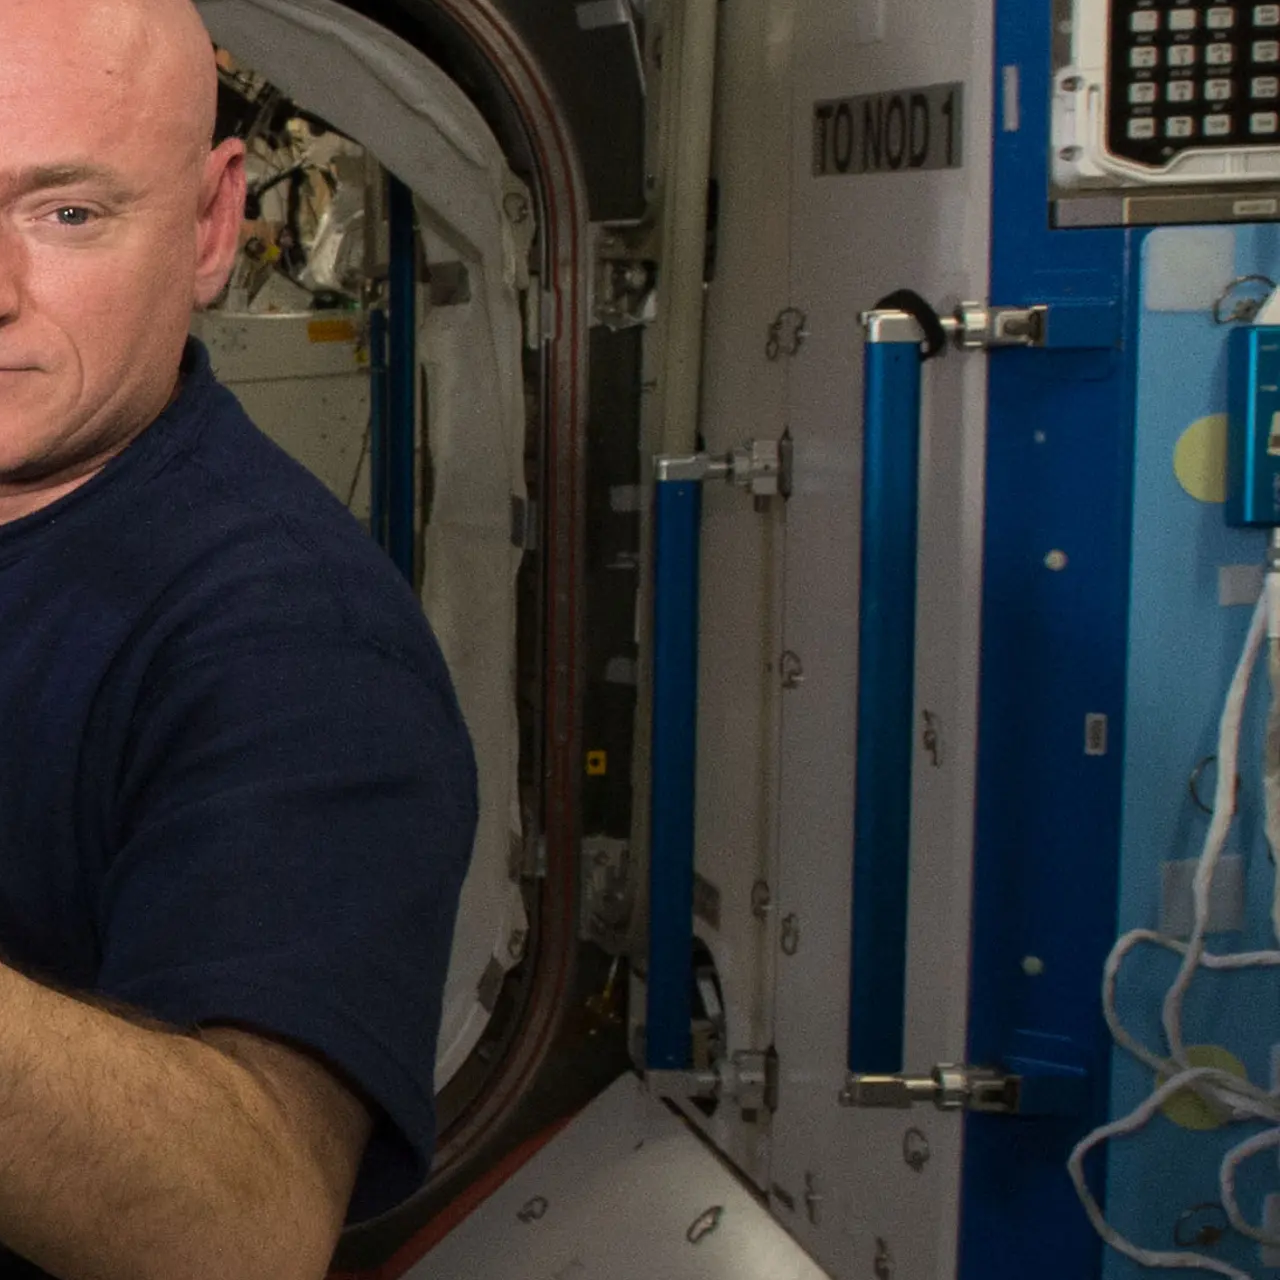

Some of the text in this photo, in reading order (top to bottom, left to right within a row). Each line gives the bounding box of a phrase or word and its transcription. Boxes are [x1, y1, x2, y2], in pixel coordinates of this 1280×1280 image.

[815, 89, 954, 174] TO NOD 1
